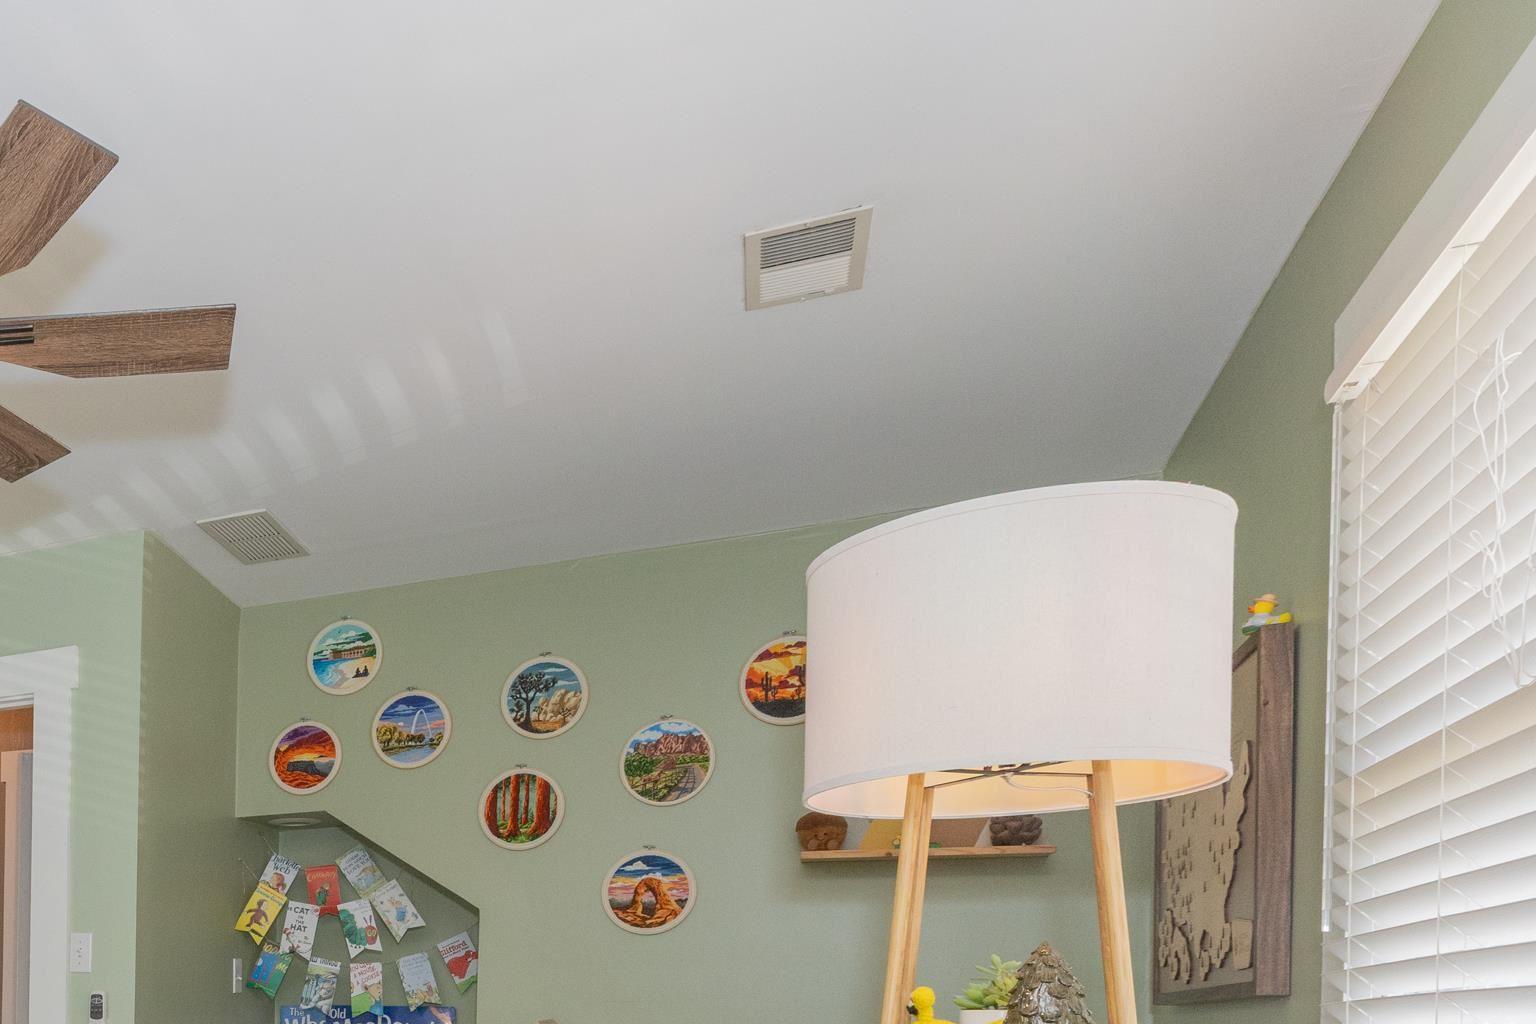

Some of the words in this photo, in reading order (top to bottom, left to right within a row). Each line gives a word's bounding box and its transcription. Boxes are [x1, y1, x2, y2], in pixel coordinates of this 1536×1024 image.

[293, 906, 310, 915] CAT
[290, 923, 308, 932] HAT
[289, 1007, 305, 1016] The
[329, 1008, 346, 1019] Old
